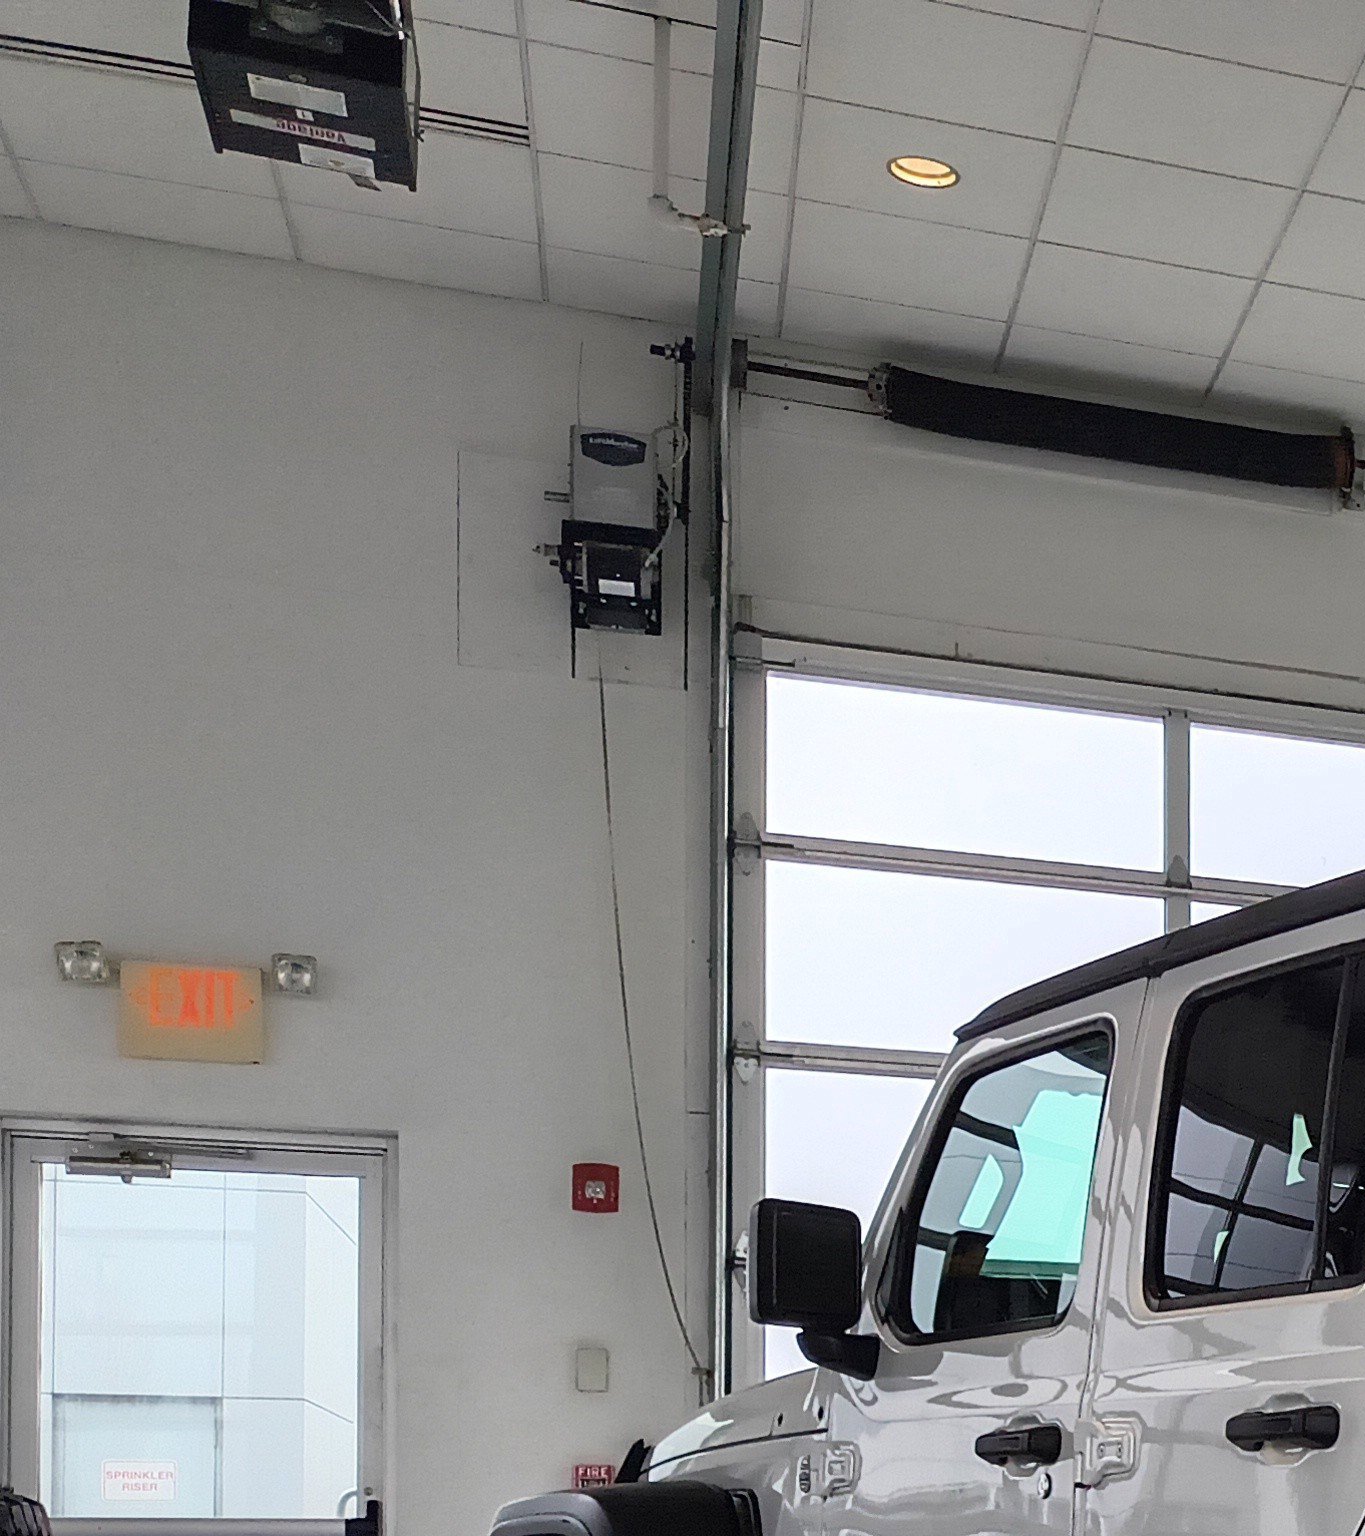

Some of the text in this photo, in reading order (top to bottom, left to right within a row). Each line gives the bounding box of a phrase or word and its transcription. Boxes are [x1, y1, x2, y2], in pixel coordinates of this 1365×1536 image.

[150, 966, 239, 1029] EXIT
[106, 1471, 174, 1480] SPRINKLER
[578, 1466, 608, 1478] FIRE
[122, 1482, 158, 1492] RISER
